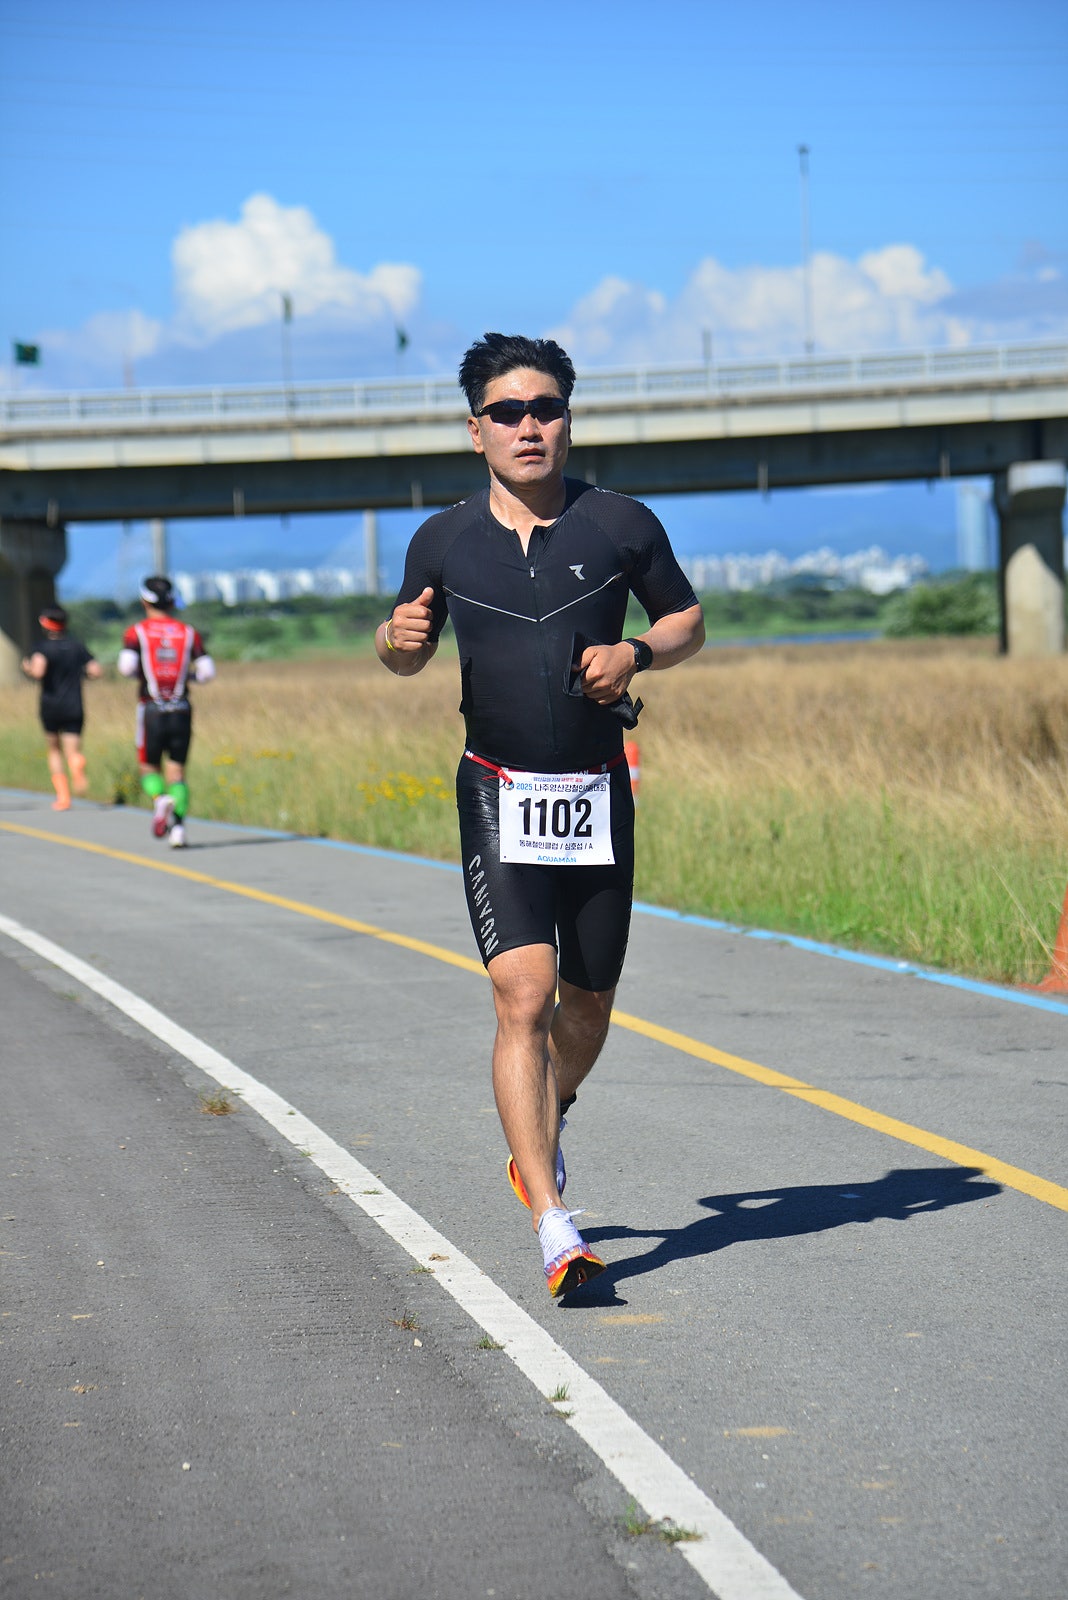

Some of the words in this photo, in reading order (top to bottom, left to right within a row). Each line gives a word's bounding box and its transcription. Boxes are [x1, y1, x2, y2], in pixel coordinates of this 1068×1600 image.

[516, 782, 533, 790] 2025
[518, 797, 593, 838] 1102
[588, 842, 593, 850] A
[537, 855, 577, 863] AQUAMAN
[468, 854, 499, 956] CANYON
